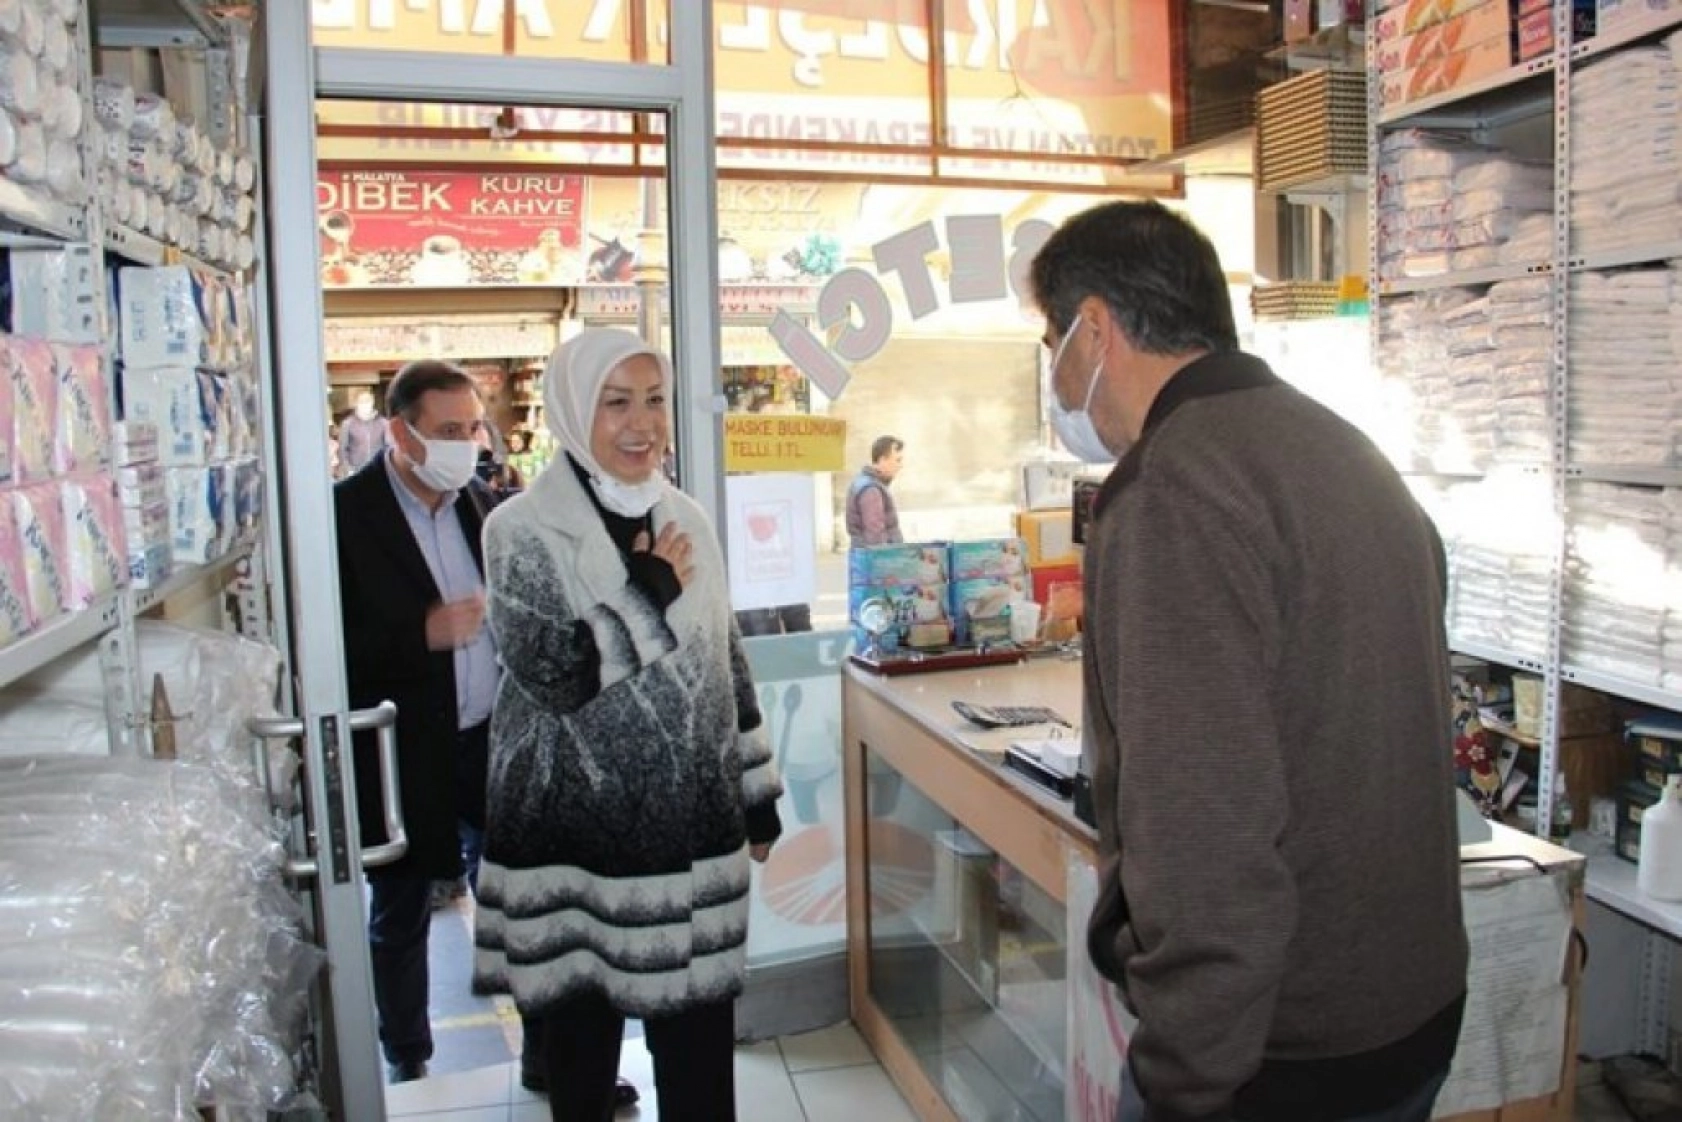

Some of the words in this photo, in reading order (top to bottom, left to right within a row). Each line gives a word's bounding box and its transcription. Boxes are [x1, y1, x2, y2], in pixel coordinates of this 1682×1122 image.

[316, 174, 452, 212] DİBEK
[481, 177, 565, 193] KURU
[470, 199, 575, 216] KAHVE
[726, 420, 773, 436] MASKE
